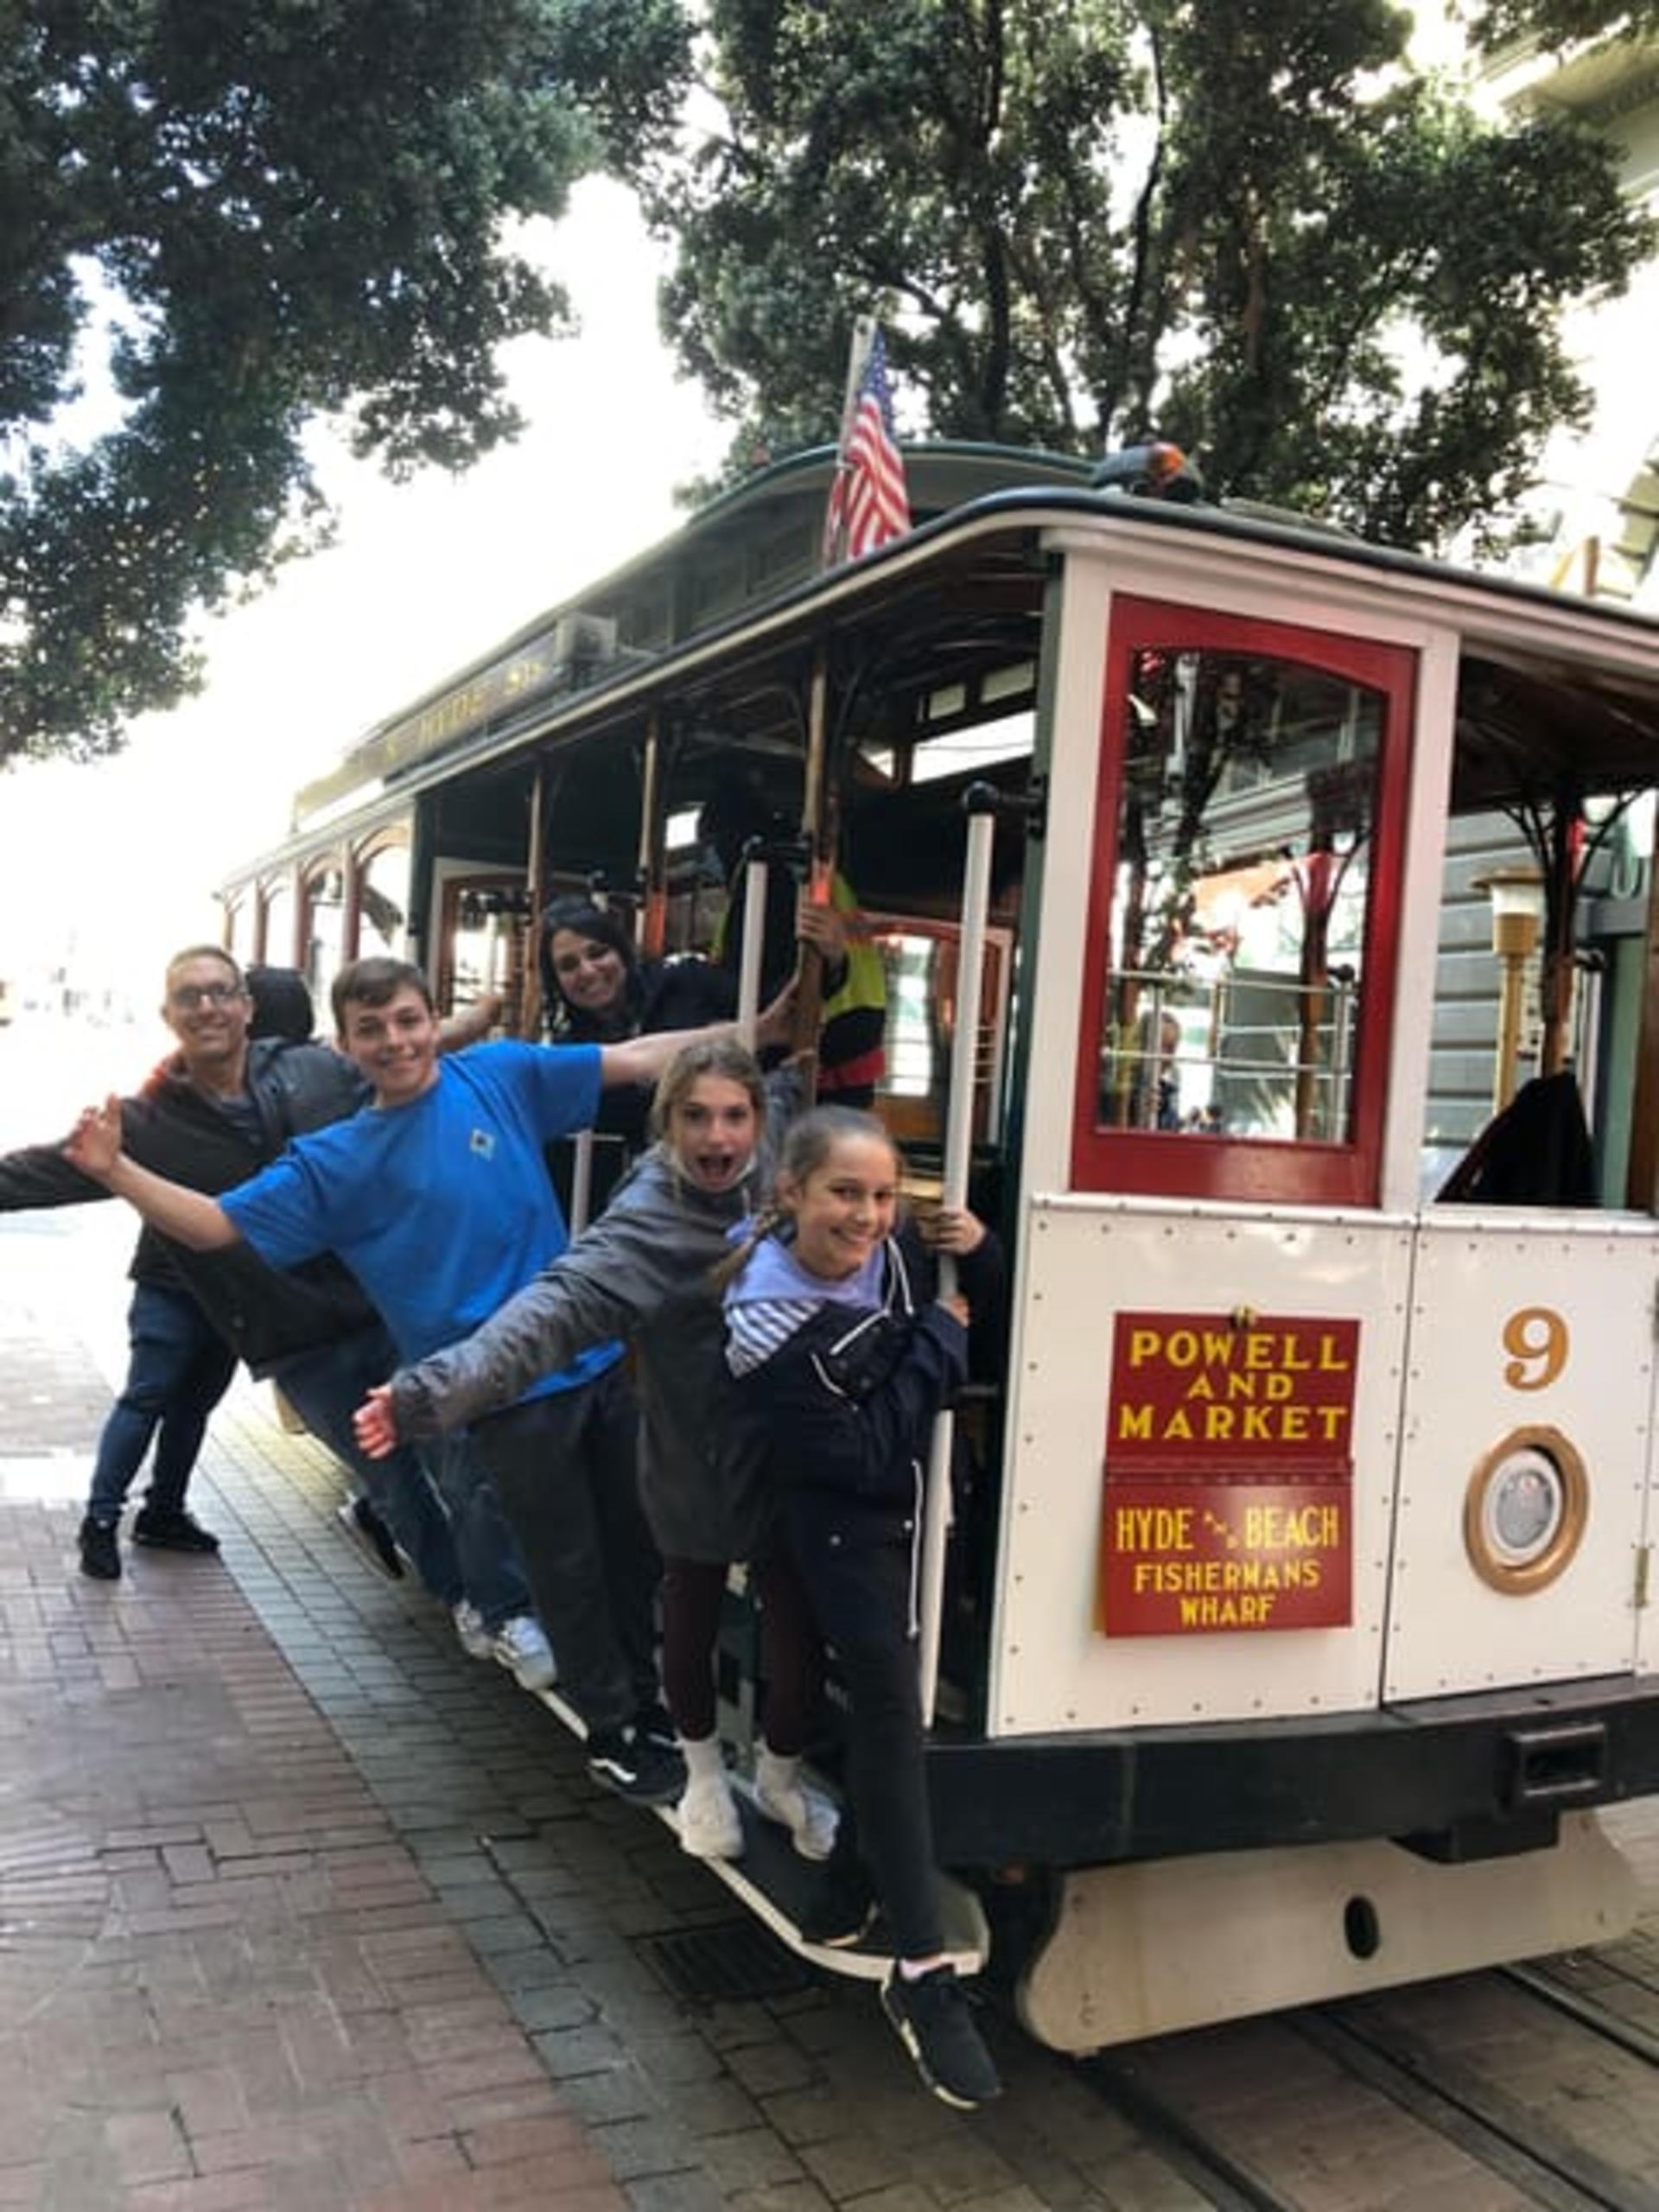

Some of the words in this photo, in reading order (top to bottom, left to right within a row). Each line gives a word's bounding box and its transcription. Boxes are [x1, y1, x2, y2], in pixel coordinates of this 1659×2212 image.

[1129, 1329, 1348, 1370] POWELL
[1503, 1306, 1570, 1391] 9
[1186, 1370, 1294, 1401] AND
[1119, 1404, 1348, 1440] MARKET
[1116, 1507, 1195, 1552] HYDE
[1245, 1505, 1339, 1550] BEACH
[1134, 1558, 1321, 1594] FISHERMANS
[1180, 1594, 1276, 1627] WHARF
